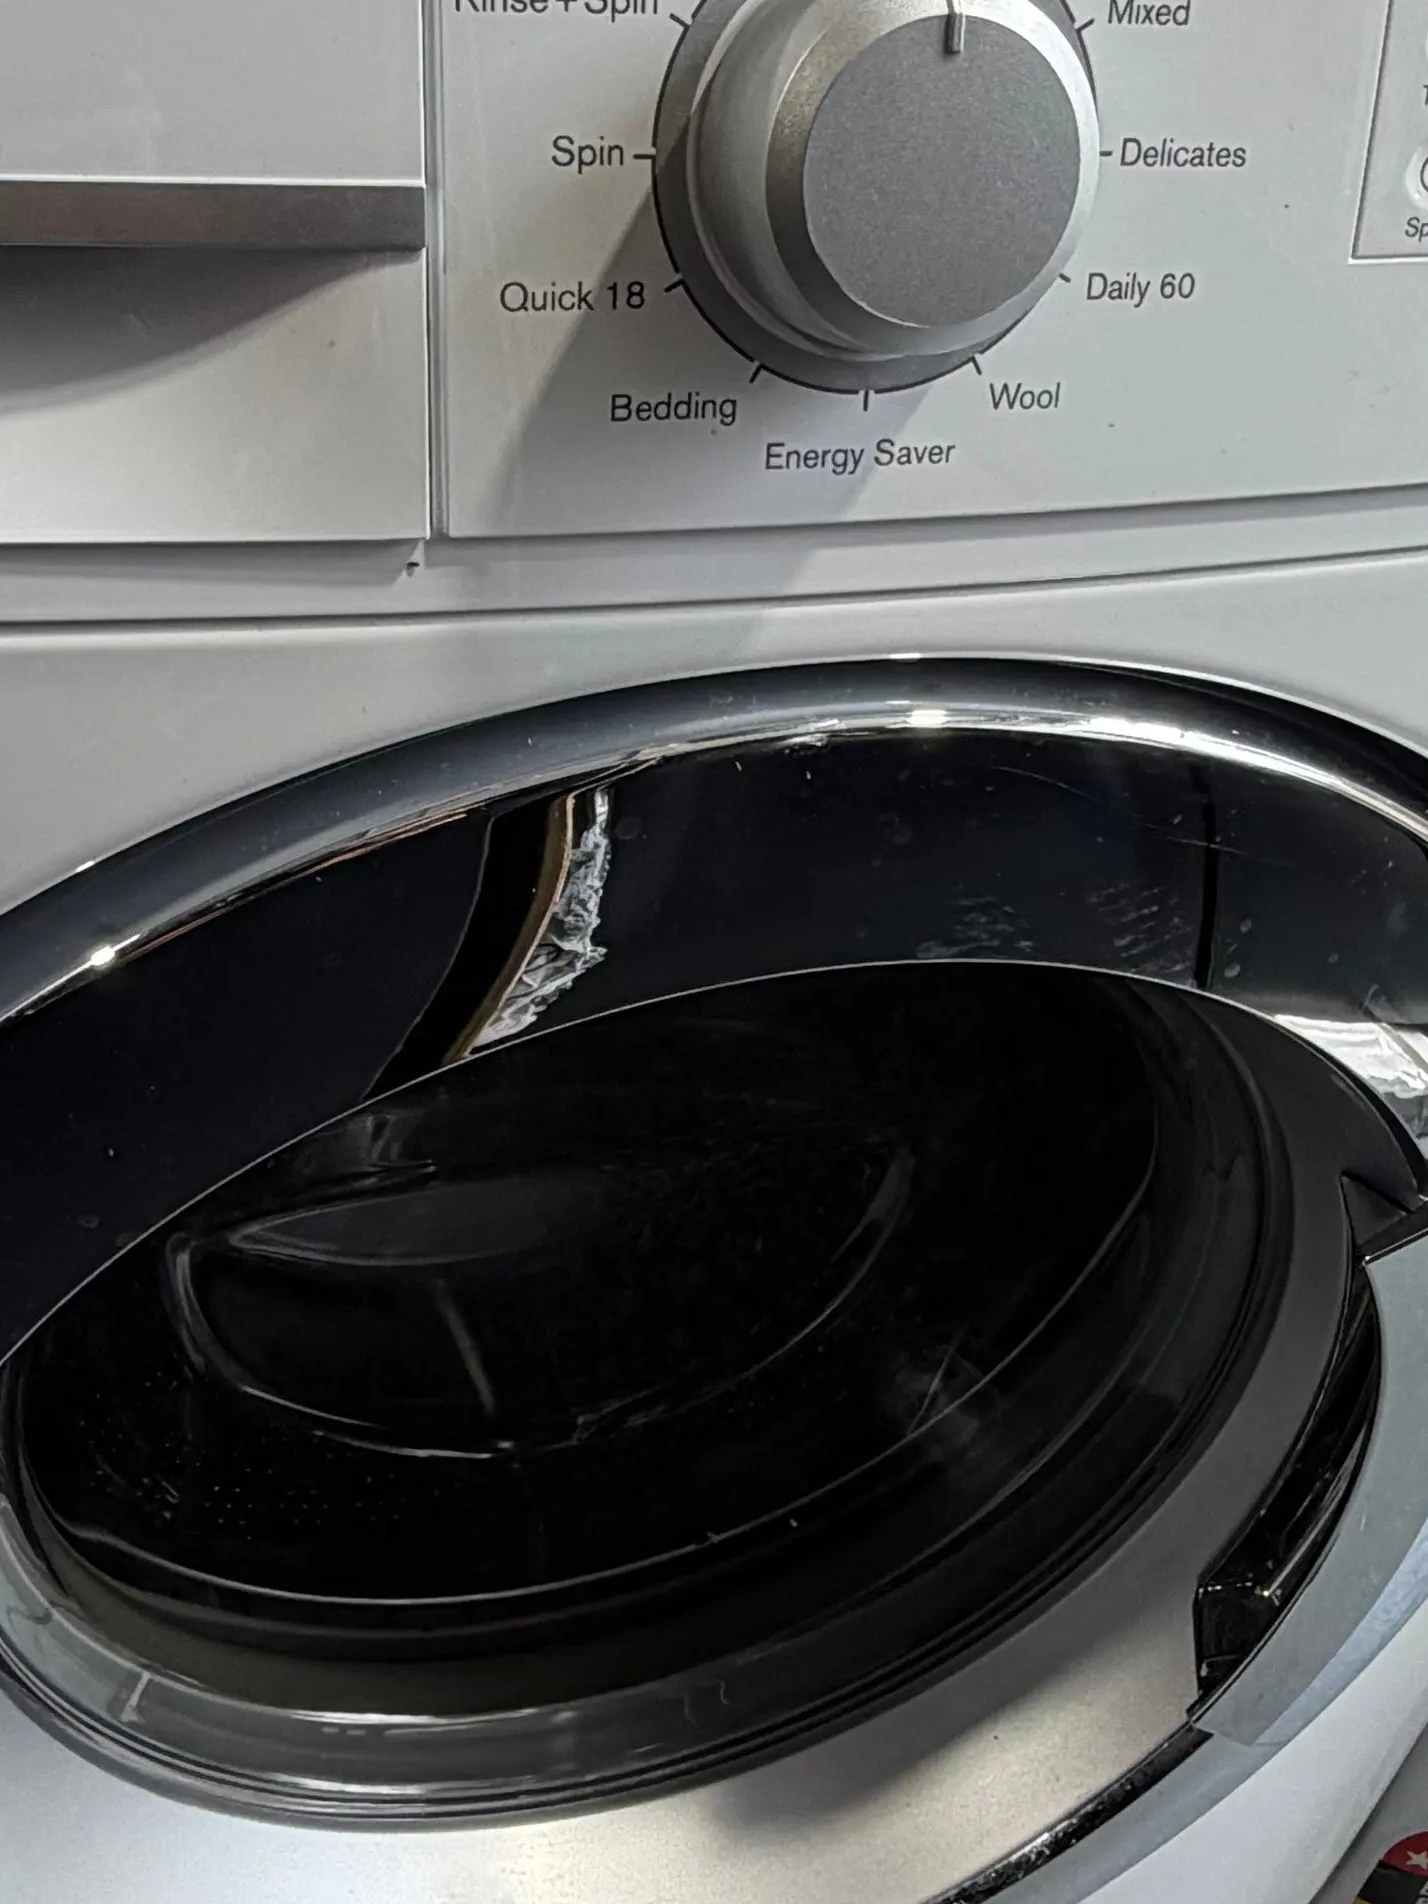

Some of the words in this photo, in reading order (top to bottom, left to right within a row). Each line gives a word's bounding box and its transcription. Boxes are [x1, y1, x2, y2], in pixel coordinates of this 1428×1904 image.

[551, 135, 624, 174] Spin
[1120, 137, 1246, 168] Delicates
[500, 281, 594, 312] Quick
[607, 281, 645, 309] 18
[1086, 272, 1151, 308] Daily
[1160, 273, 1195, 300] 60
[610, 393, 737, 426] Bedding
[989, 382, 1061, 411] Wool
[765, 443, 864, 475] Energy
[874, 439, 956, 468] Saver
